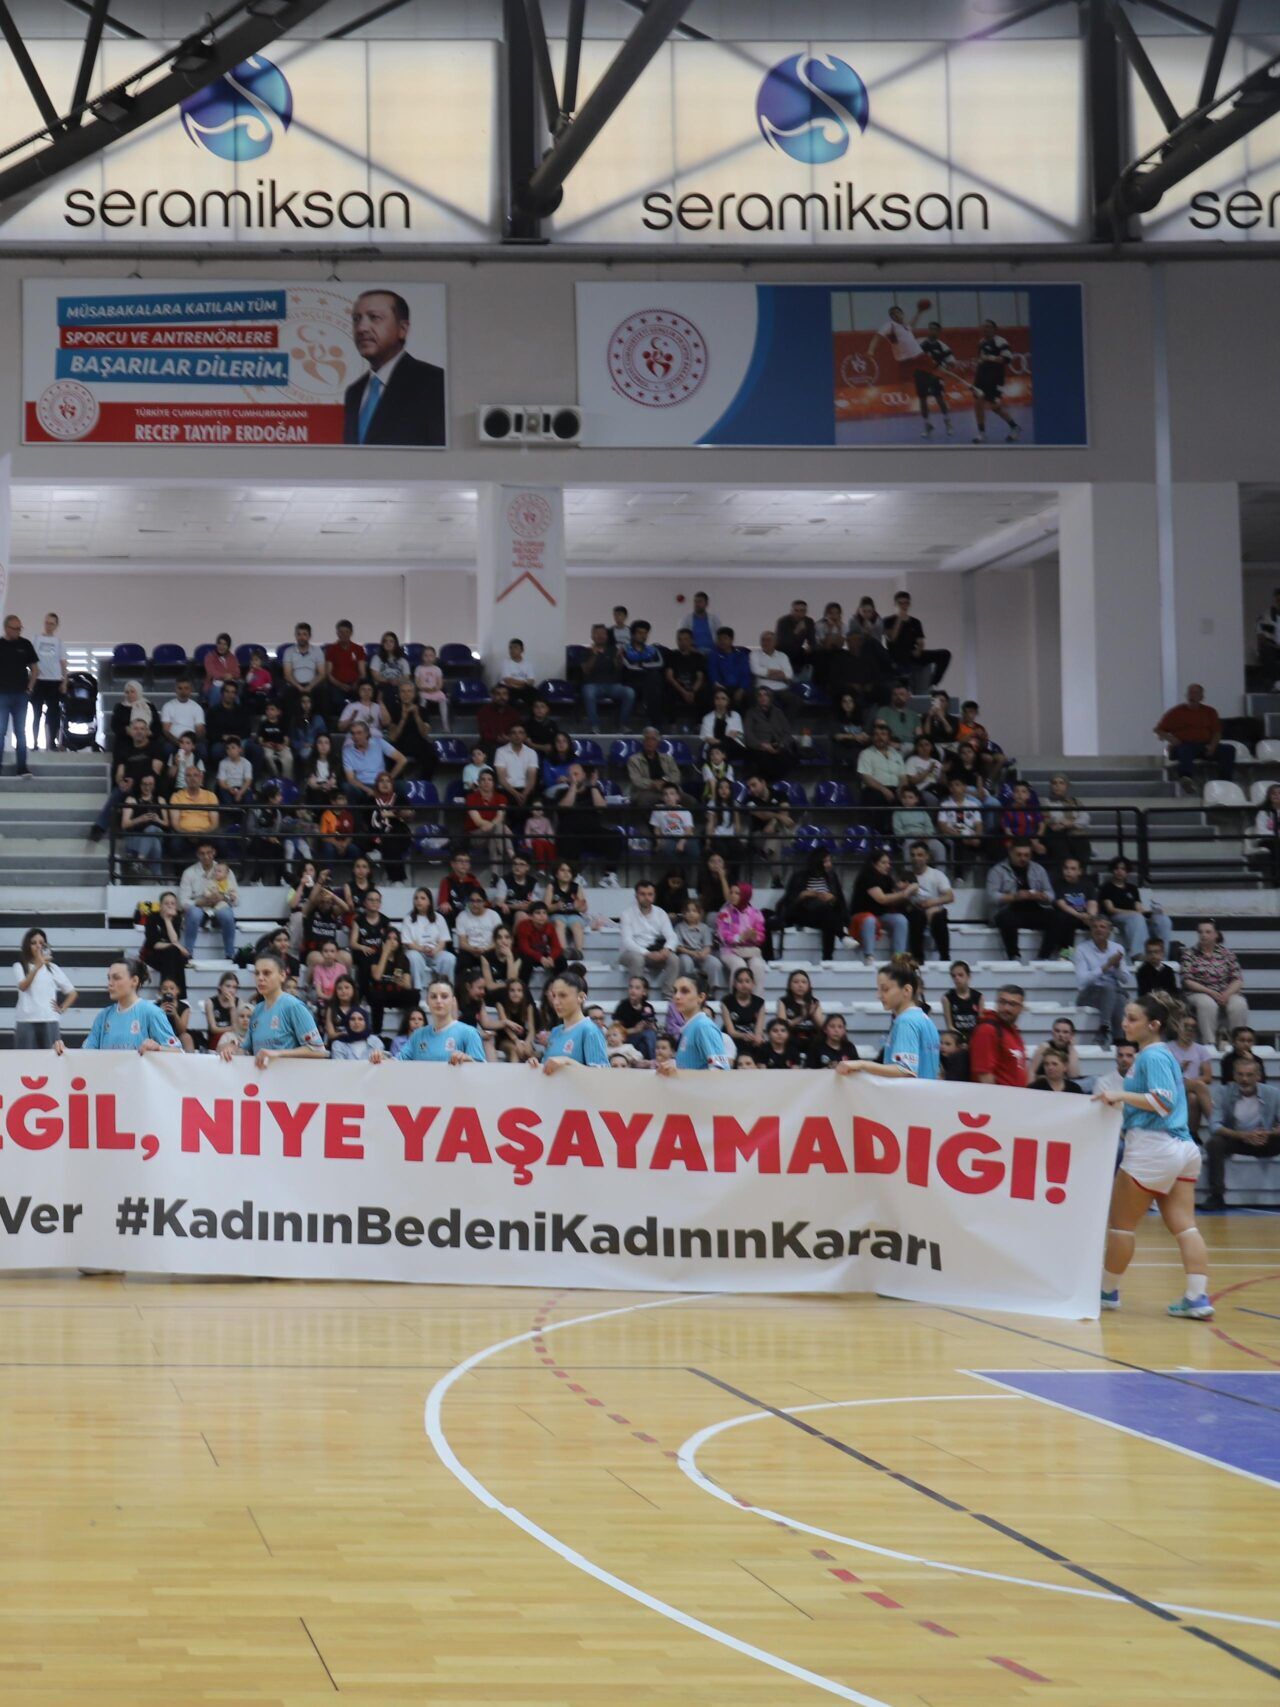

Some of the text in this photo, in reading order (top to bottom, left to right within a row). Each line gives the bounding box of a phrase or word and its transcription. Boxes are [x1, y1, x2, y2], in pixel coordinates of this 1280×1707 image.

[64, 179, 411, 229] seramiksan
[642, 182, 989, 231] seramiksan
[66, 298, 278, 319] MÜSABAKALARA KATILAN TÜM
[65, 328, 273, 345] SPORCU VE ANTRENÖRLERE
[71, 354, 288, 379] BAŞARILAR DİLERİM.
[134, 421, 308, 442] RECEP TAYYİP ERDOĞAN
[181, 1084, 365, 1159] NİYE
[388, 1104, 1072, 1205] YAŞAYAMADIĞI!
[116, 1196, 943, 1271] #KadınınBedeniKadınınKararı
